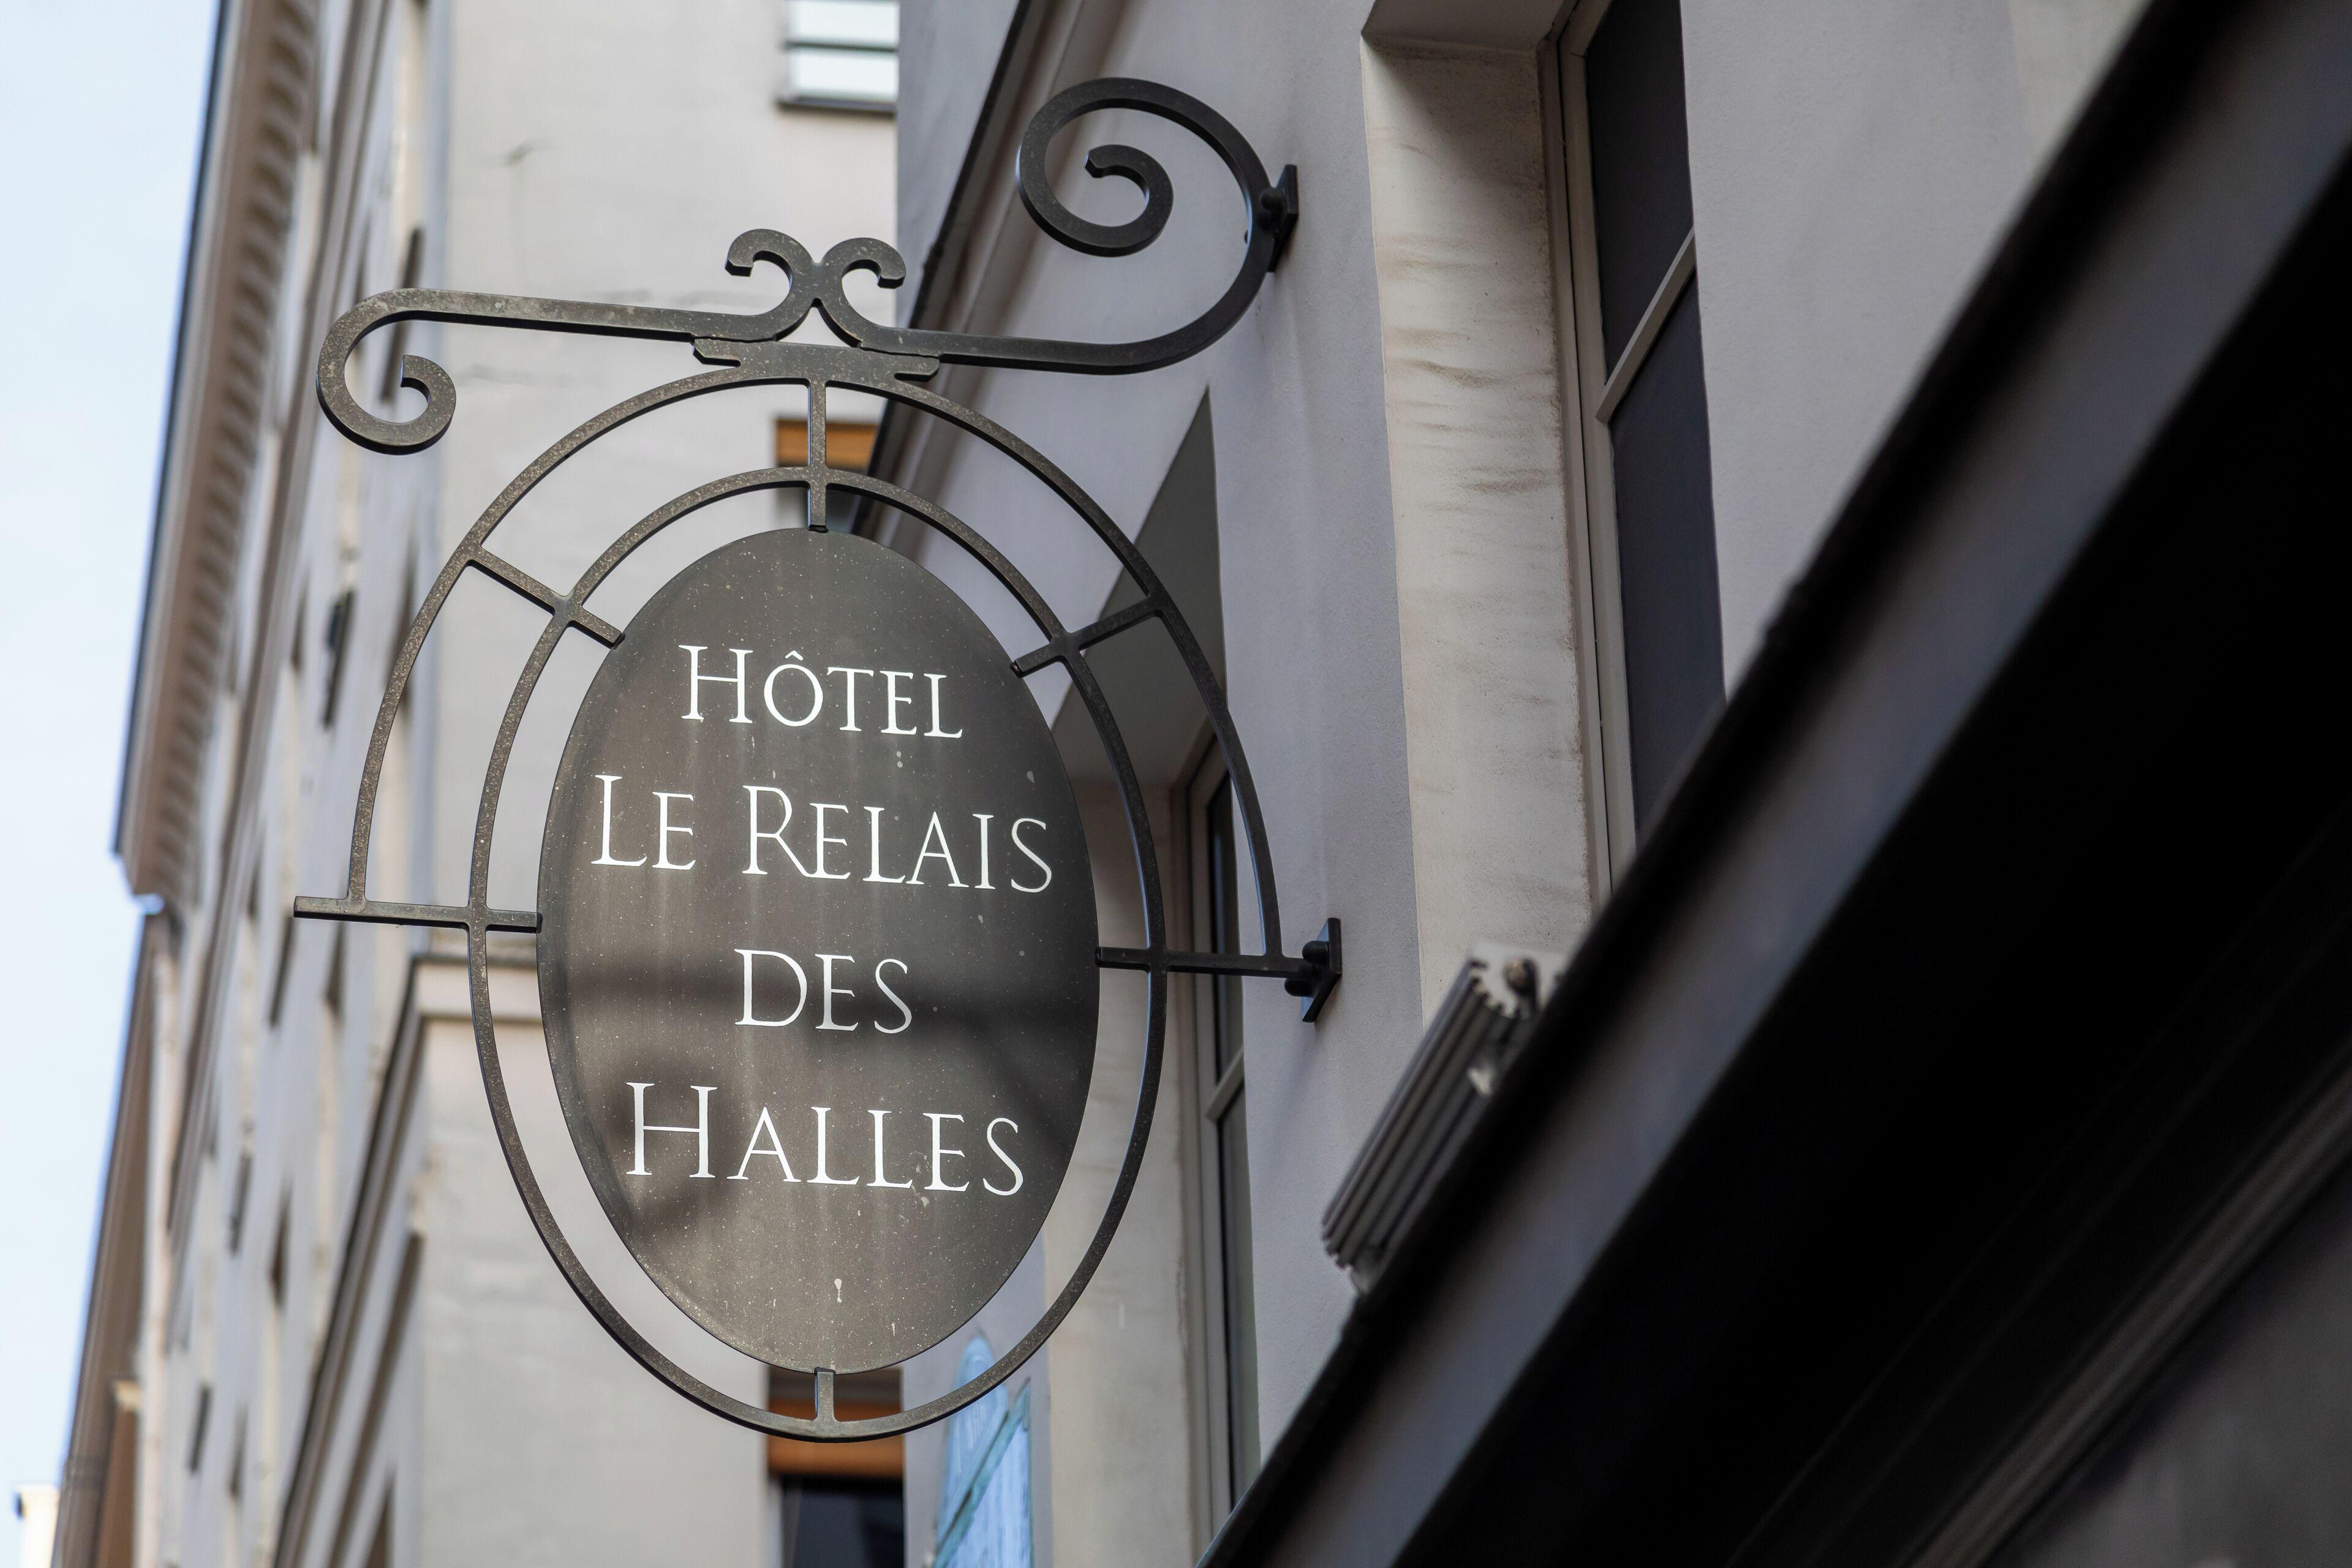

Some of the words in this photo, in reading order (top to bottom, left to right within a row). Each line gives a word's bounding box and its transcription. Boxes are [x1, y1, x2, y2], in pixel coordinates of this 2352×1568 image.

[678, 644, 963, 739] HÔTEL
[590, 774, 696, 870] LE
[742, 785, 1053, 894] RELAIS
[734, 948, 913, 1035] DES
[625, 1082, 1024, 1197] HALLES
